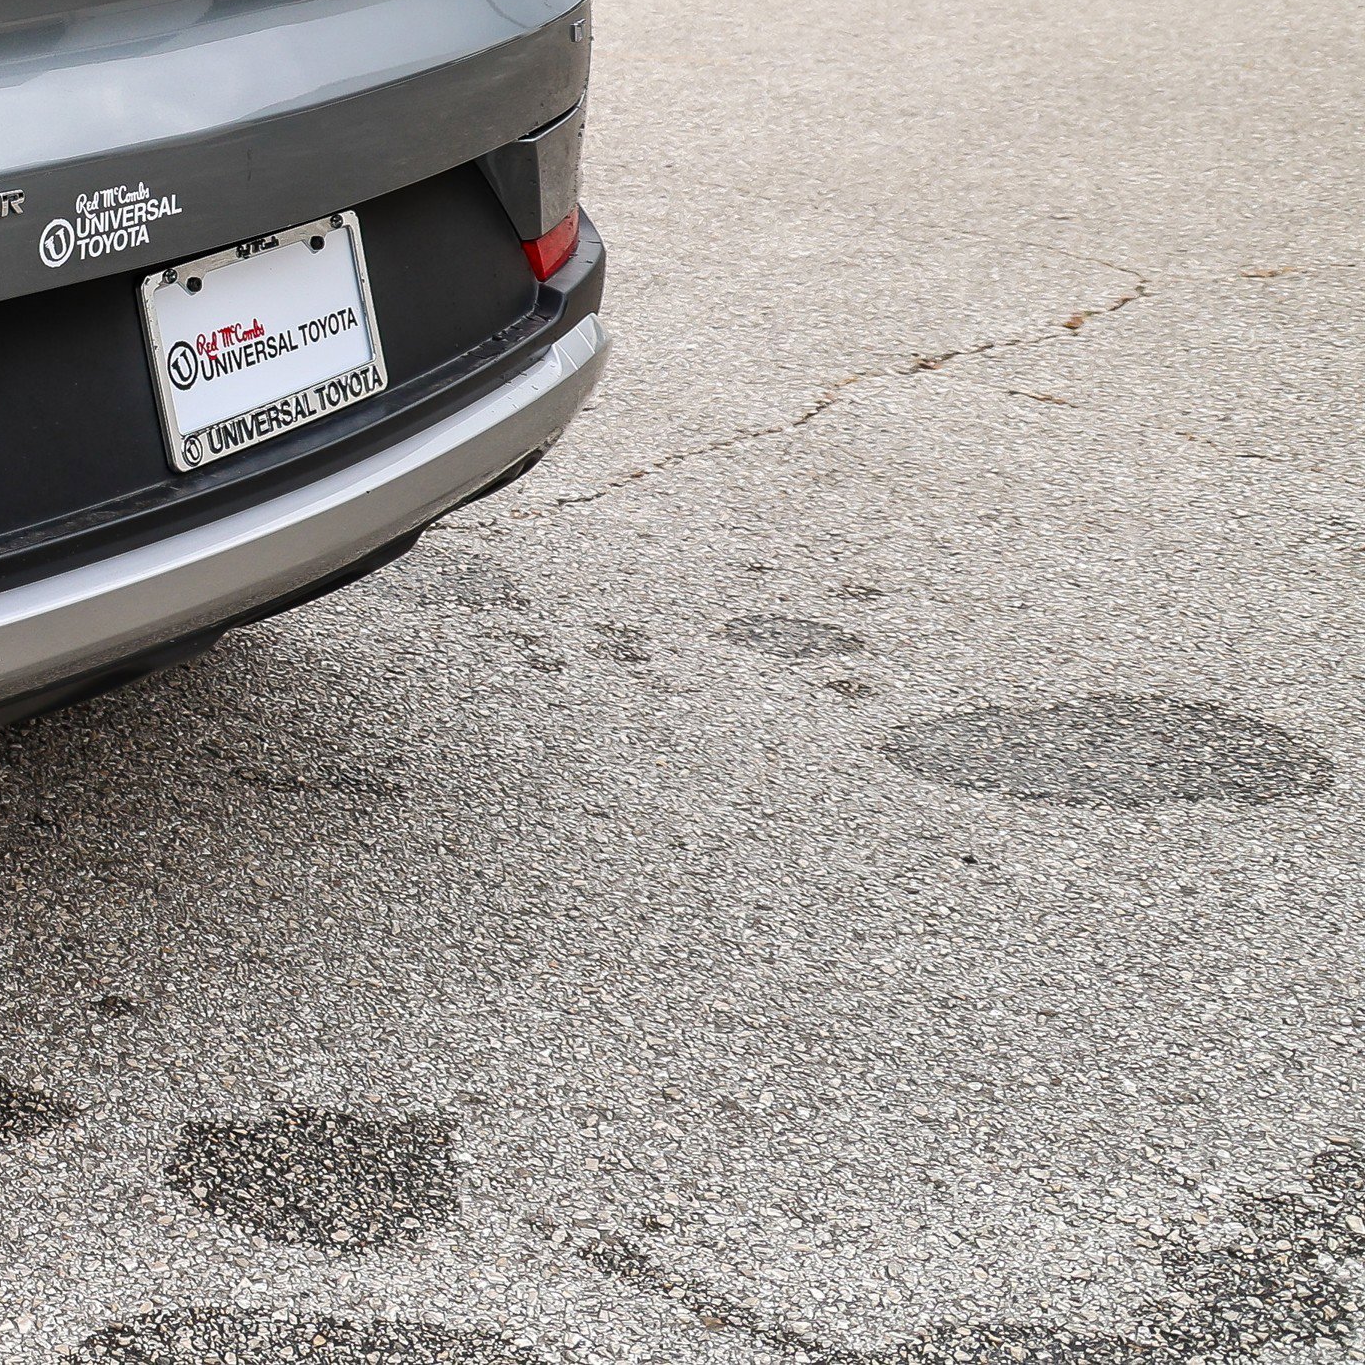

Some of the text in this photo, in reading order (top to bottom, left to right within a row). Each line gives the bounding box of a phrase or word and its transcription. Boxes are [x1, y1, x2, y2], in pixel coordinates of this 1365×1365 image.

[76, 182, 150, 219] Red McCombs
[76, 194, 183, 238] UNIVERSAL
[76, 224, 150, 260] TOYOTA
[196, 318, 265, 360] Red McCombs
[200, 307, 359, 381] UNIVERSAL TOYOTA
[206, 365, 384, 454] UNIVERSAL TOYOTA
